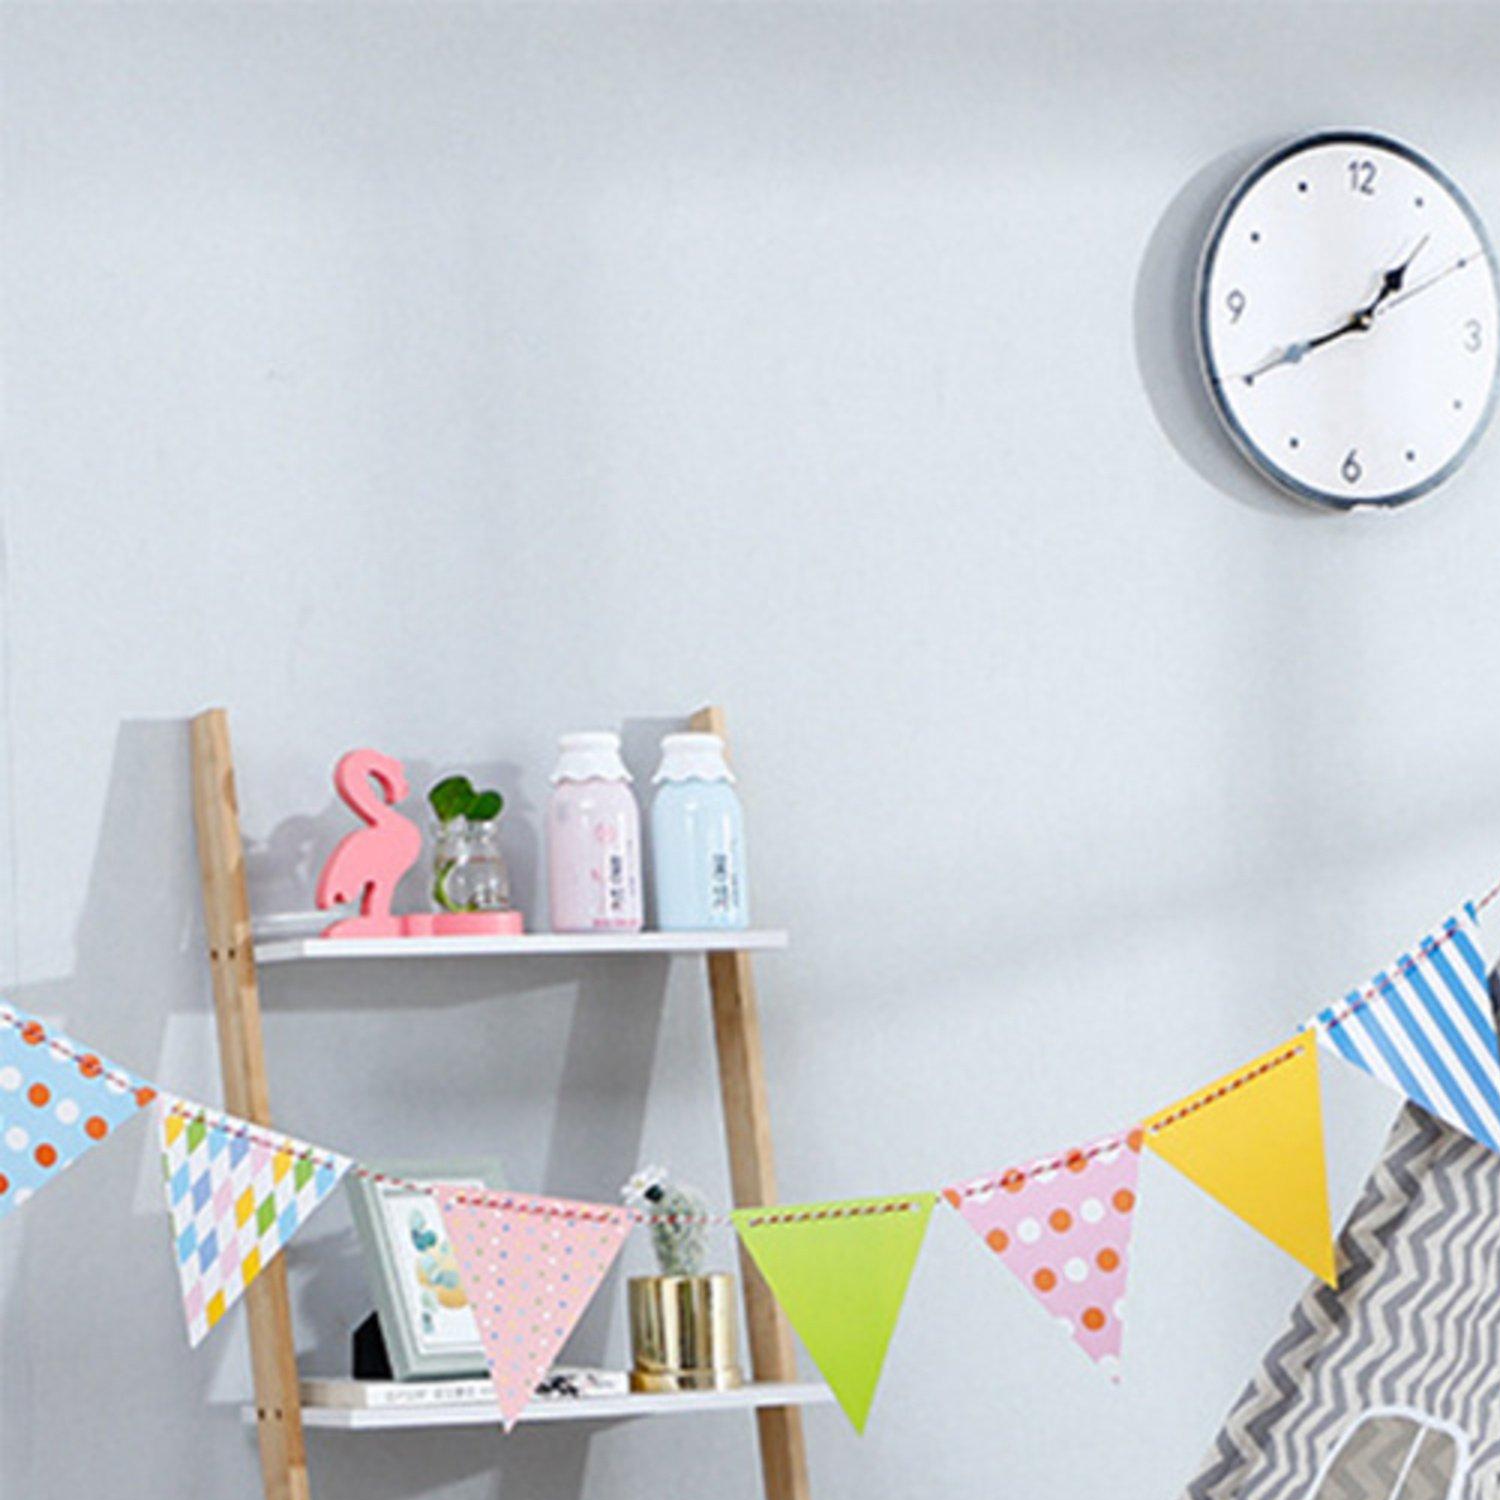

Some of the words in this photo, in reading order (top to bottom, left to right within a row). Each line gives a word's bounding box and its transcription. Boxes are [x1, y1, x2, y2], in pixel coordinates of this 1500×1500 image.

[1348, 160, 1377, 195] 12
[1226, 289, 1245, 324] 9
[1464, 318, 1482, 353] 3
[1340, 448, 1361, 484] 6
